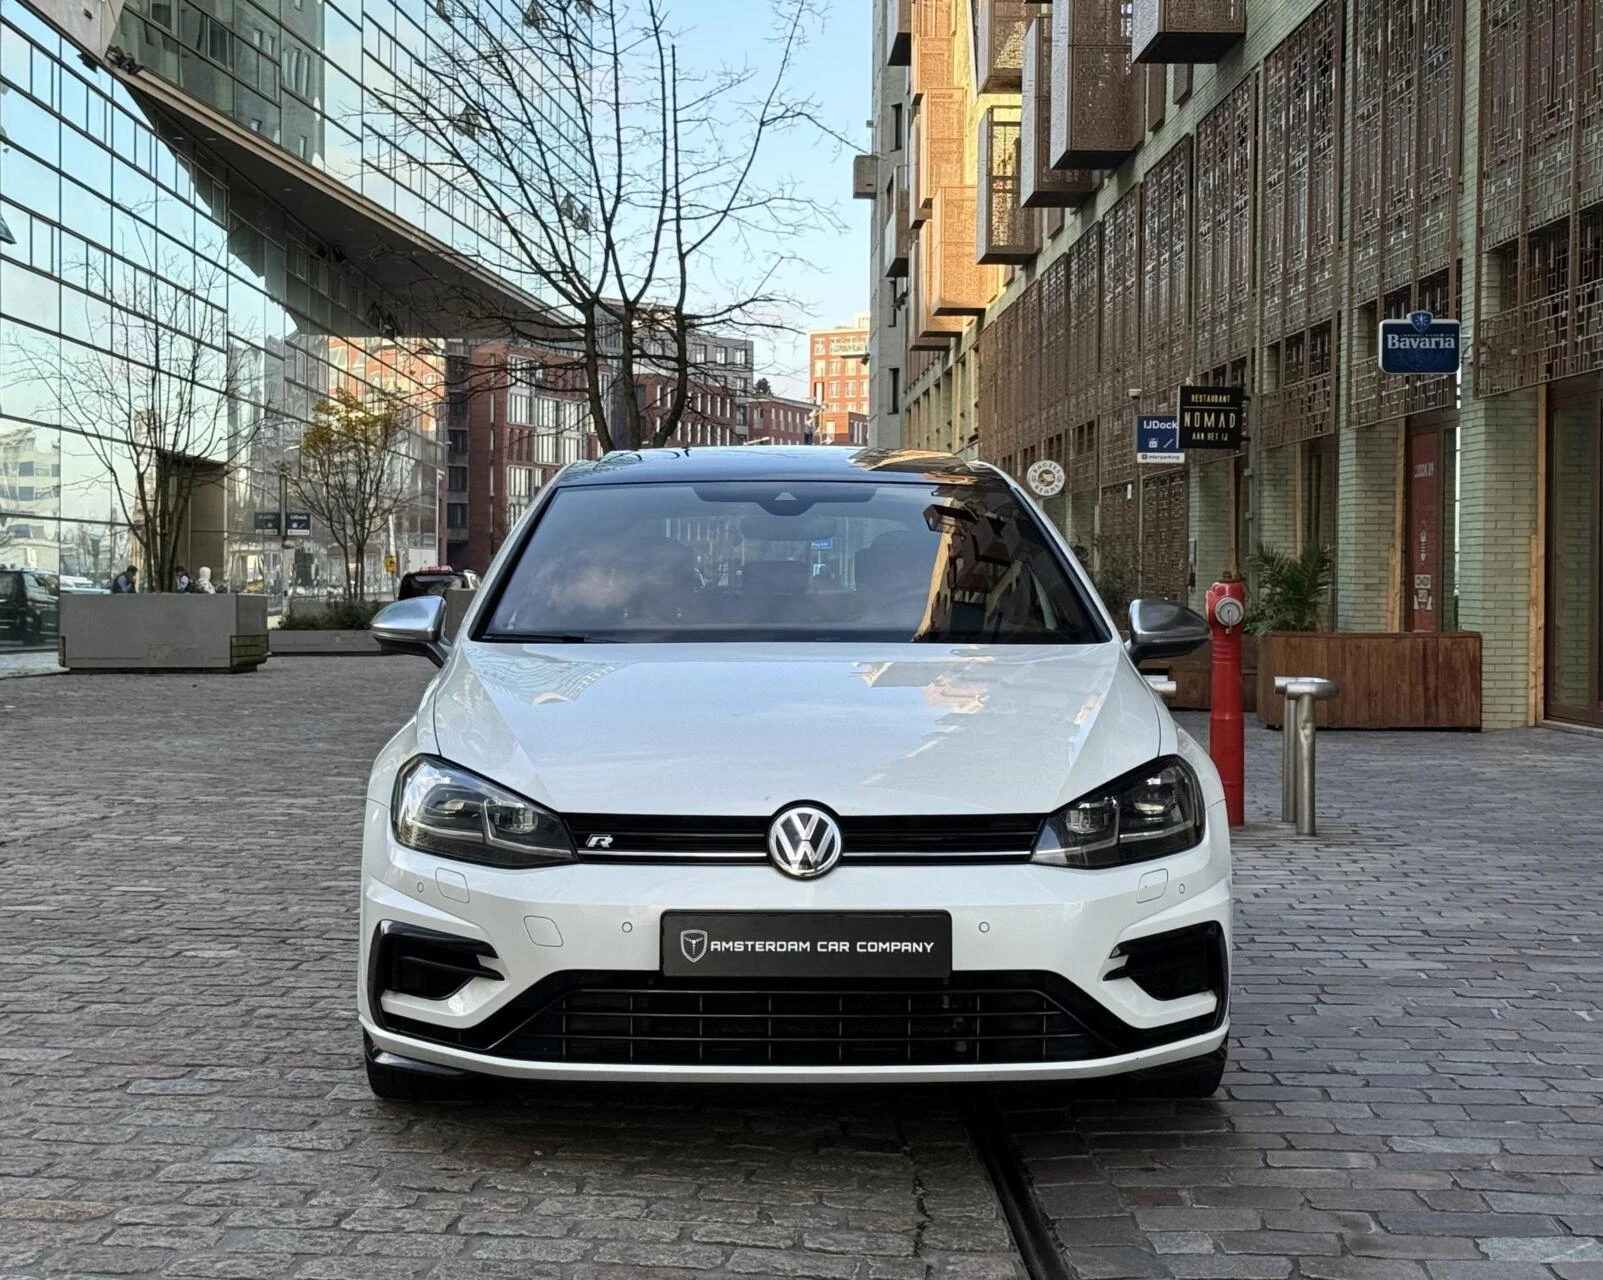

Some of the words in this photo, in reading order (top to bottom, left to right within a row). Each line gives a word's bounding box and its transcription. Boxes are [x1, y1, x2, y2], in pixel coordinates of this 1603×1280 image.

[1387, 333, 1456, 349] Bavaria
[1191, 393, 1231, 403] RESTAURANT
[1143, 420, 1178, 430] IJDock
[1184, 411, 1236, 429] NOMAD
[1192, 432, 1205, 441] AAN
[586, 833, 614, 848] R
[710, 941, 811, 952] AMSTERDAM
[817, 941, 850, 952] CAR
[856, 941, 935, 953] COMPANY
